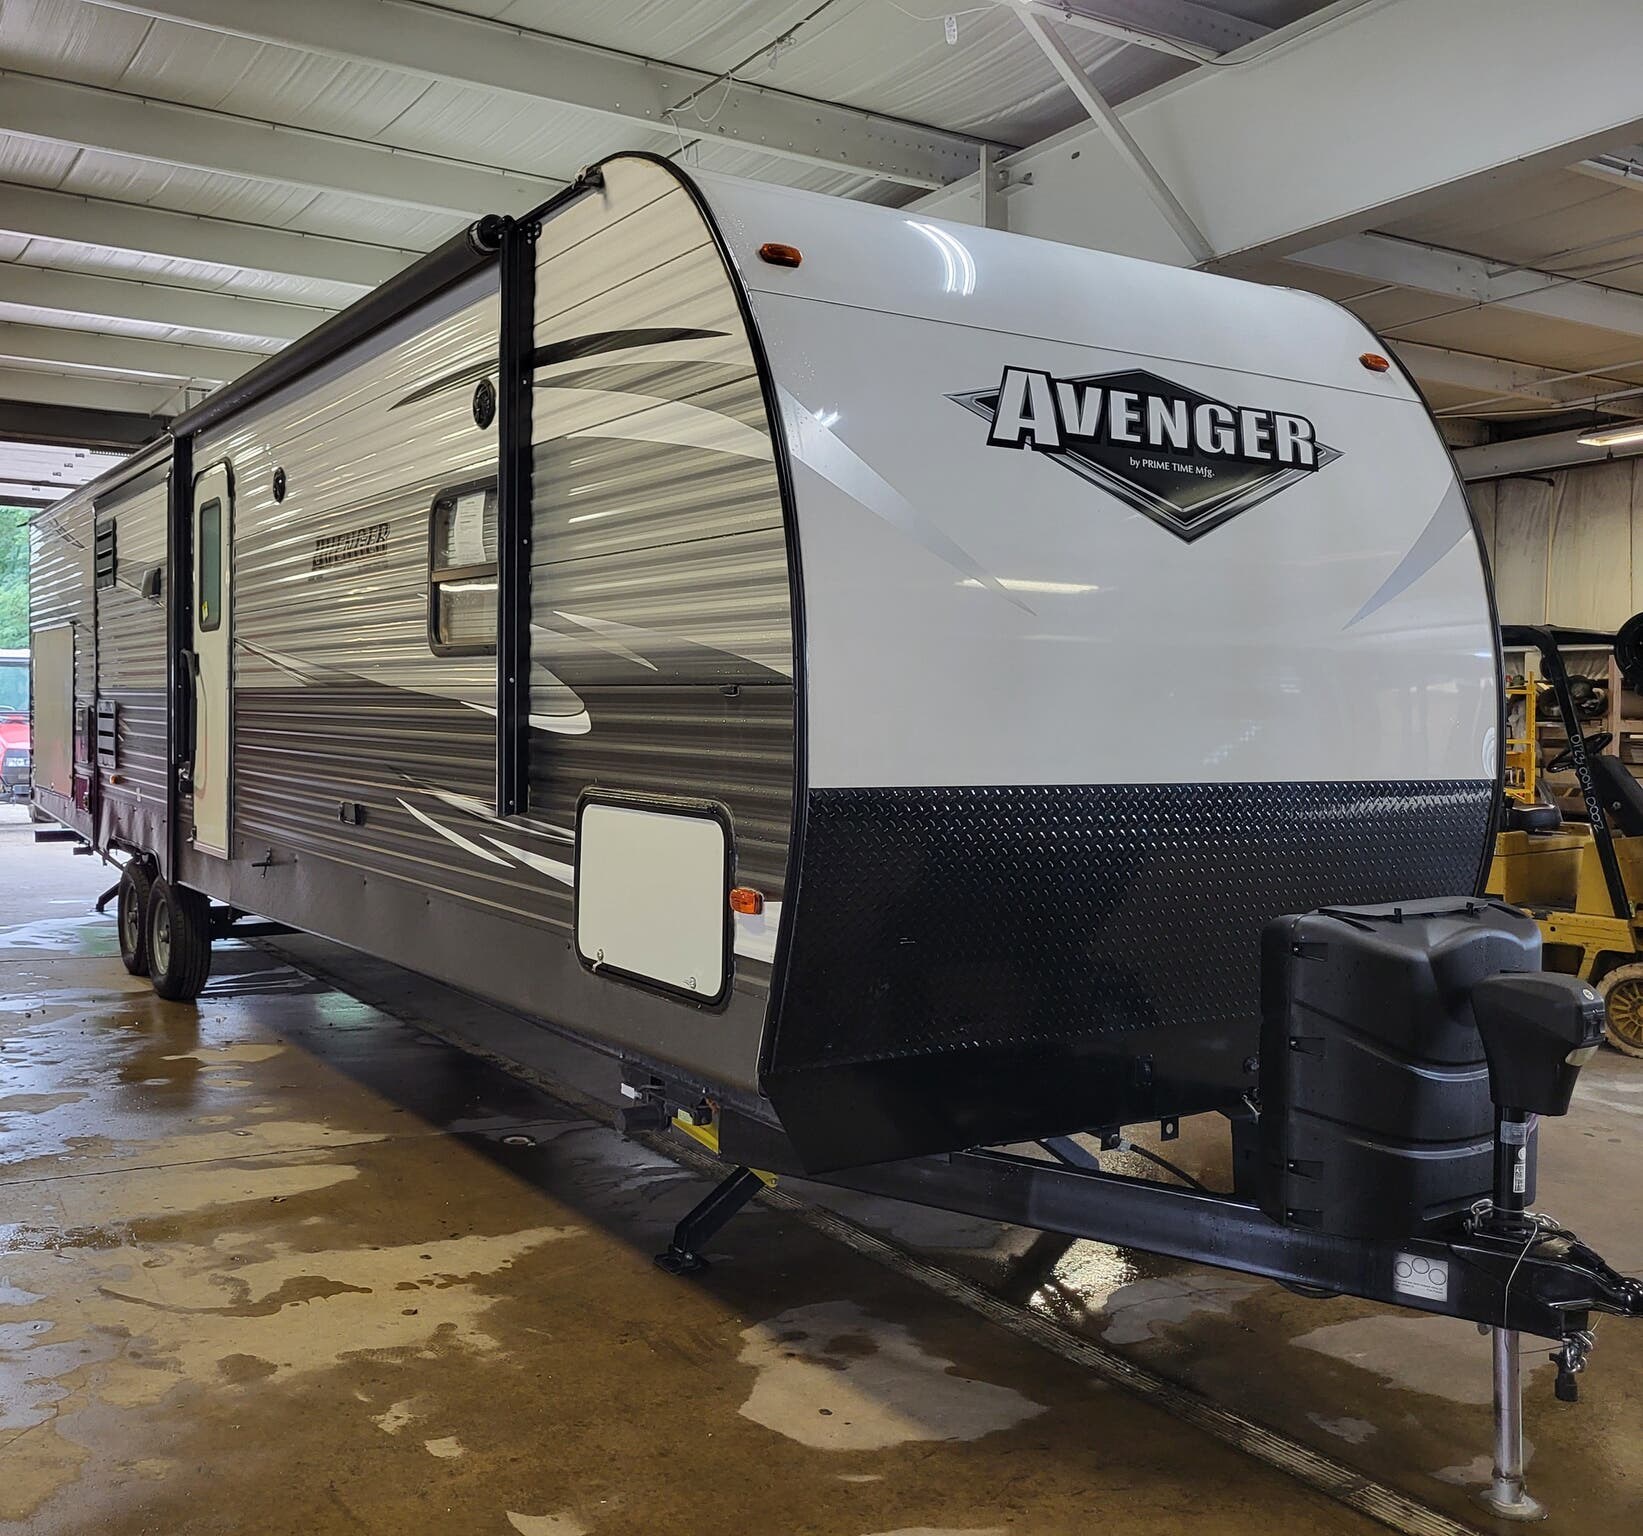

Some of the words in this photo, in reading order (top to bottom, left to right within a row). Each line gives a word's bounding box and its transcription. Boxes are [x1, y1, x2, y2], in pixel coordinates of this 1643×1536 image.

[988, 366, 1318, 470] AVENGER
[1129, 456, 1141, 469] by
[1142, 458, 1170, 471] PRIME
[1171, 462, 1194, 474] TIME
[1195, 465, 1216, 479] Mfg.
